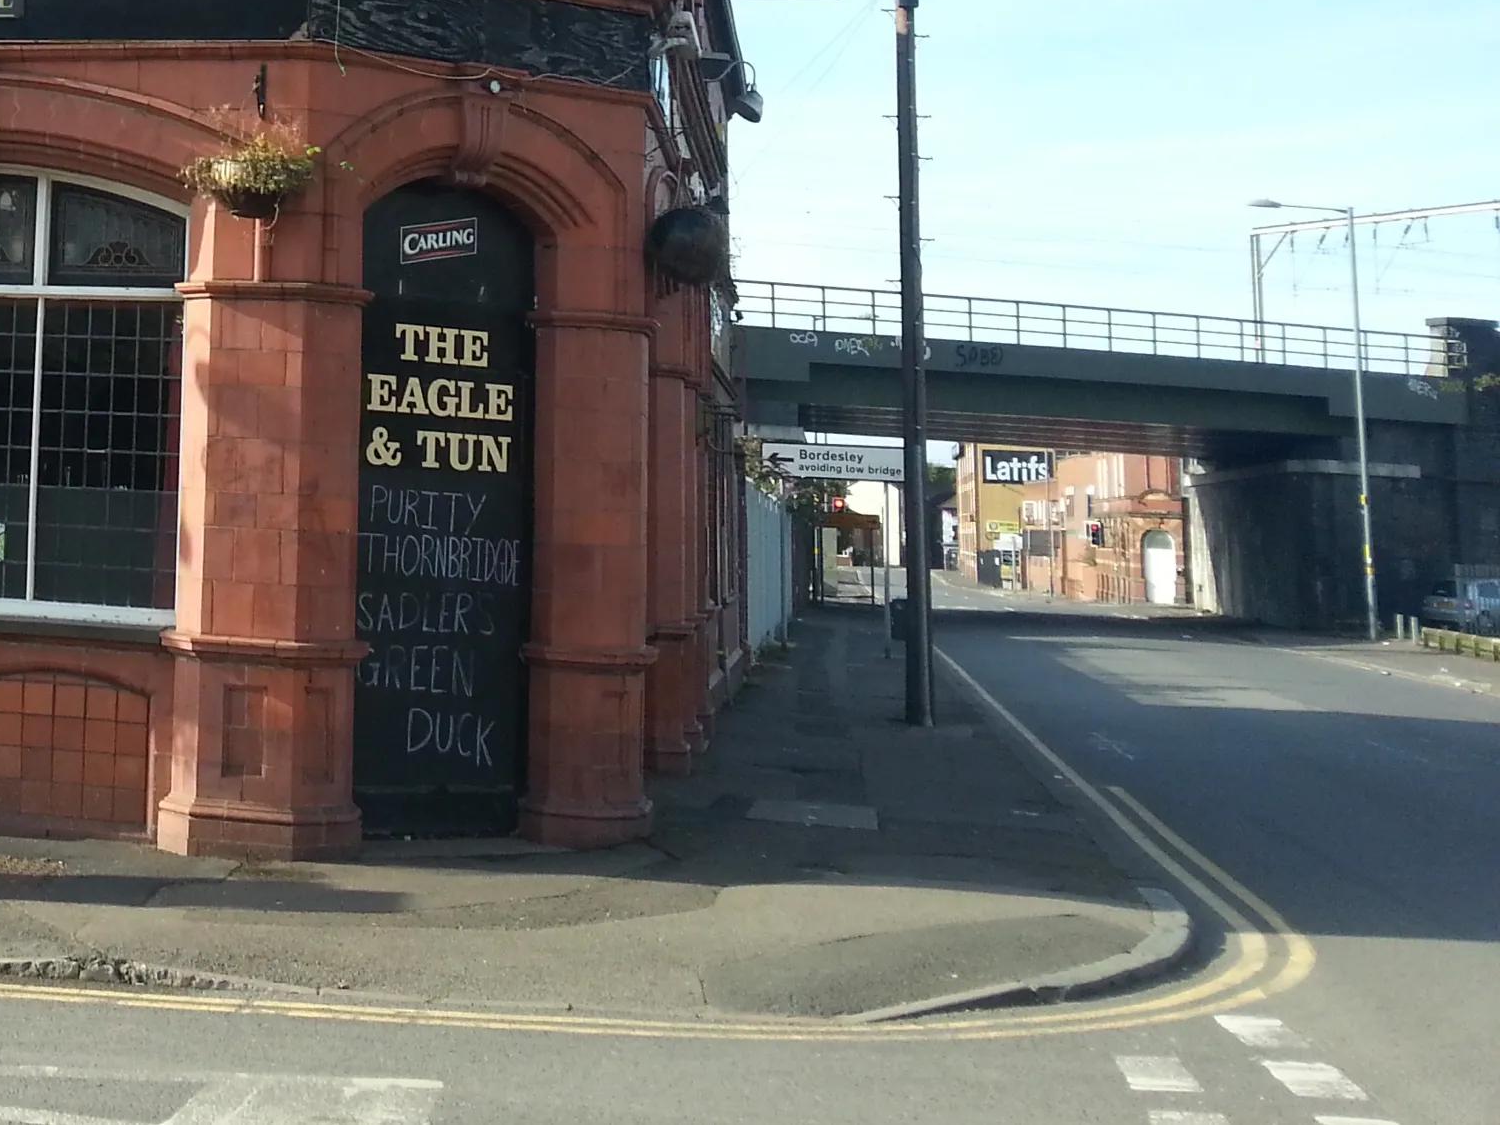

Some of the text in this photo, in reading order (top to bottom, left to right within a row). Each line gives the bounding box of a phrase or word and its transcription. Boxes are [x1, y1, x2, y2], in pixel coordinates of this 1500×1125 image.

[403, 228, 474, 255] CARLING
[395, 323, 489, 367] THE
[367, 373, 514, 421] EAGLE
[366, 426, 512, 473] & TUN
[798, 463, 902, 476] avoiding low bridge
[799, 449, 864, 464] Bordesley
[985, 455, 1048, 482] Latifs
[370, 485, 487, 536] PURITY
[356, 645, 476, 698] GREEN
[407, 708, 496, 768] DUCK
